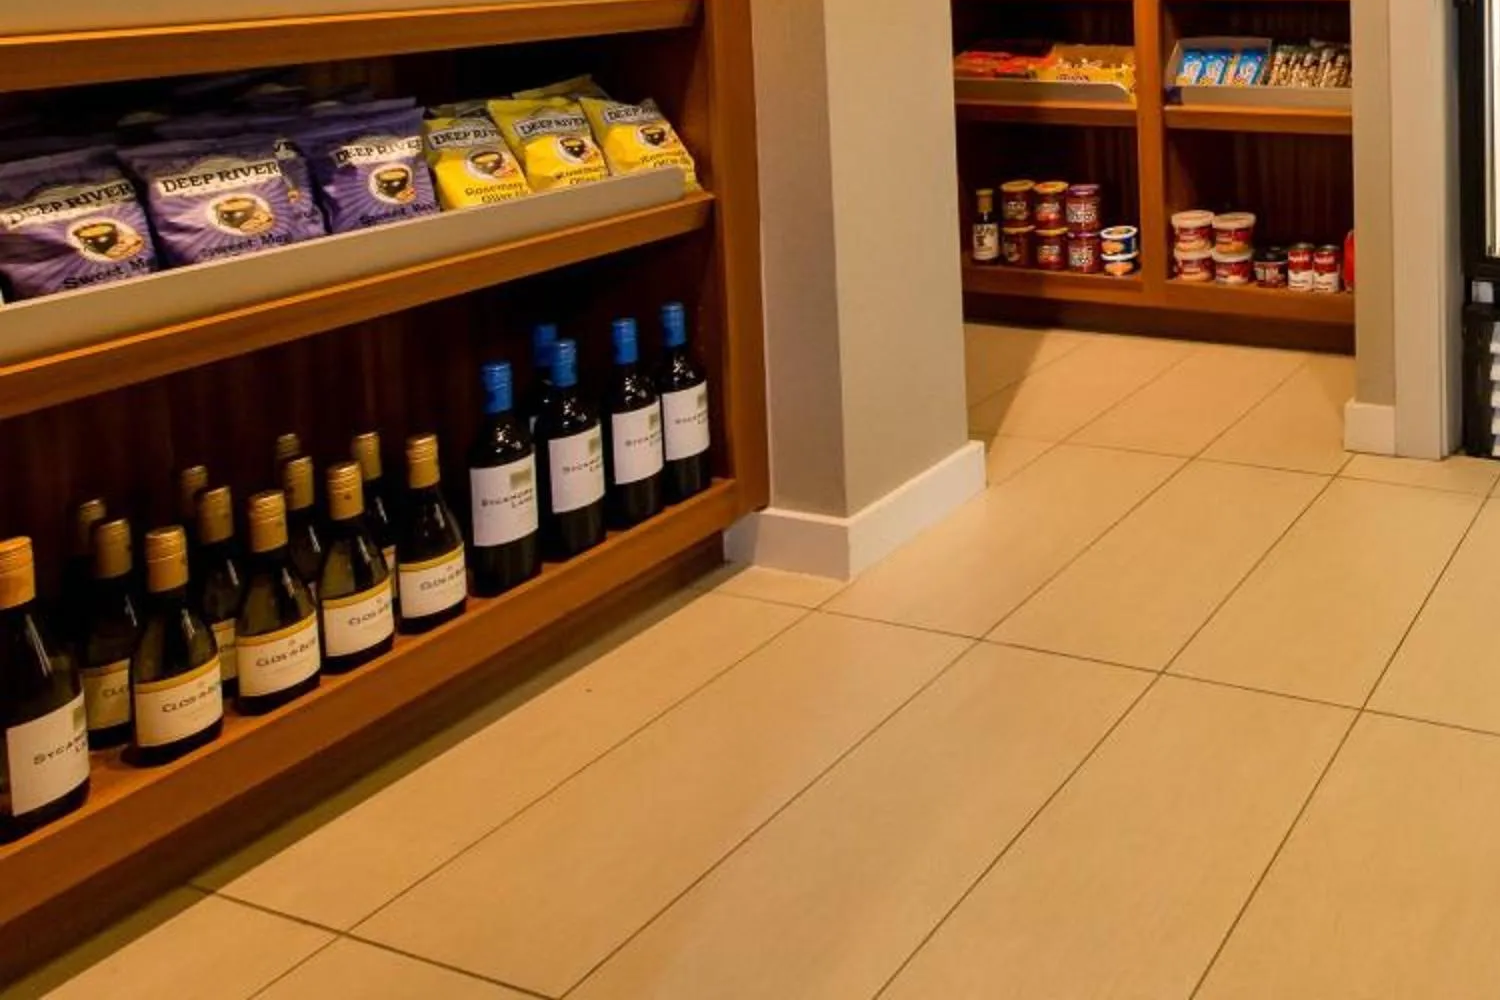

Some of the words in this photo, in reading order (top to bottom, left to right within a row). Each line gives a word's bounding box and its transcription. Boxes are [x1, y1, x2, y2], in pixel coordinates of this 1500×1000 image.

[473, 127, 499, 142] RIV
[162, 171, 215, 194] DEEP
[217, 160, 280, 184] RIVER
[67, 181, 134, 211] RIVER
[256, 652, 288, 668] CLOS
[161, 694, 197, 713] CLOS
